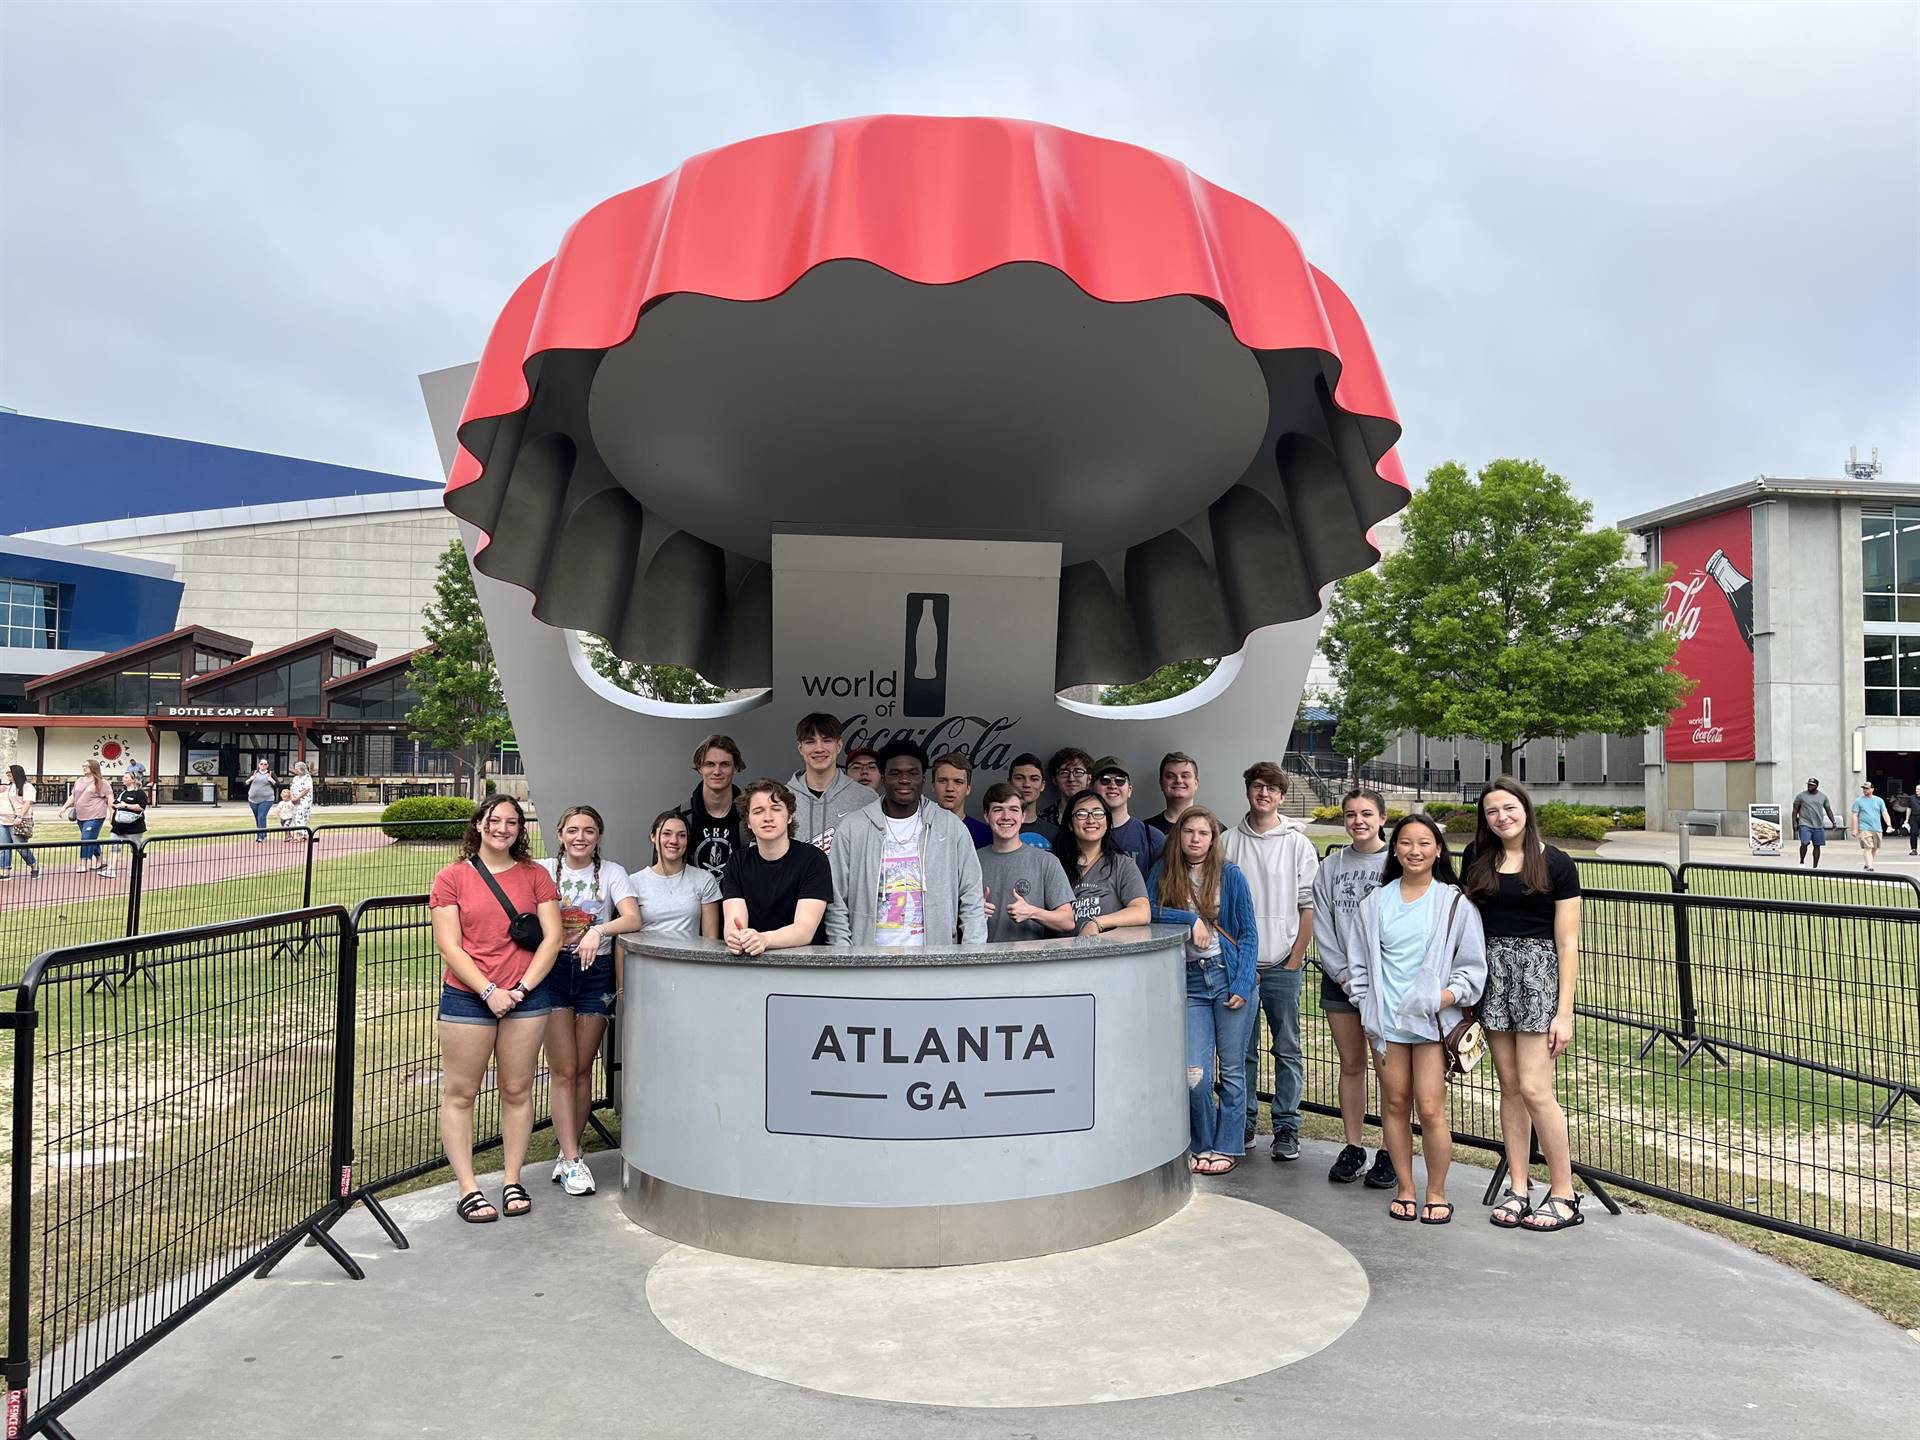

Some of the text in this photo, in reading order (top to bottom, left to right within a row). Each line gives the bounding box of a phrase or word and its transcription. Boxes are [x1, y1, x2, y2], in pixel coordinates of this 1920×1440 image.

[801, 670, 897, 698] world
[169, 707, 274, 717] BOTTLE CAP CAFÉ
[875, 700, 896, 717] of
[93, 734, 119, 757] BOTTLE
[703, 827, 730, 839] CKY
[1072, 897, 1090, 909] ruin
[1074, 906, 1101, 921] ation
[811, 1024, 1055, 1064] ATLANTA
[906, 1081, 967, 1111] GA
